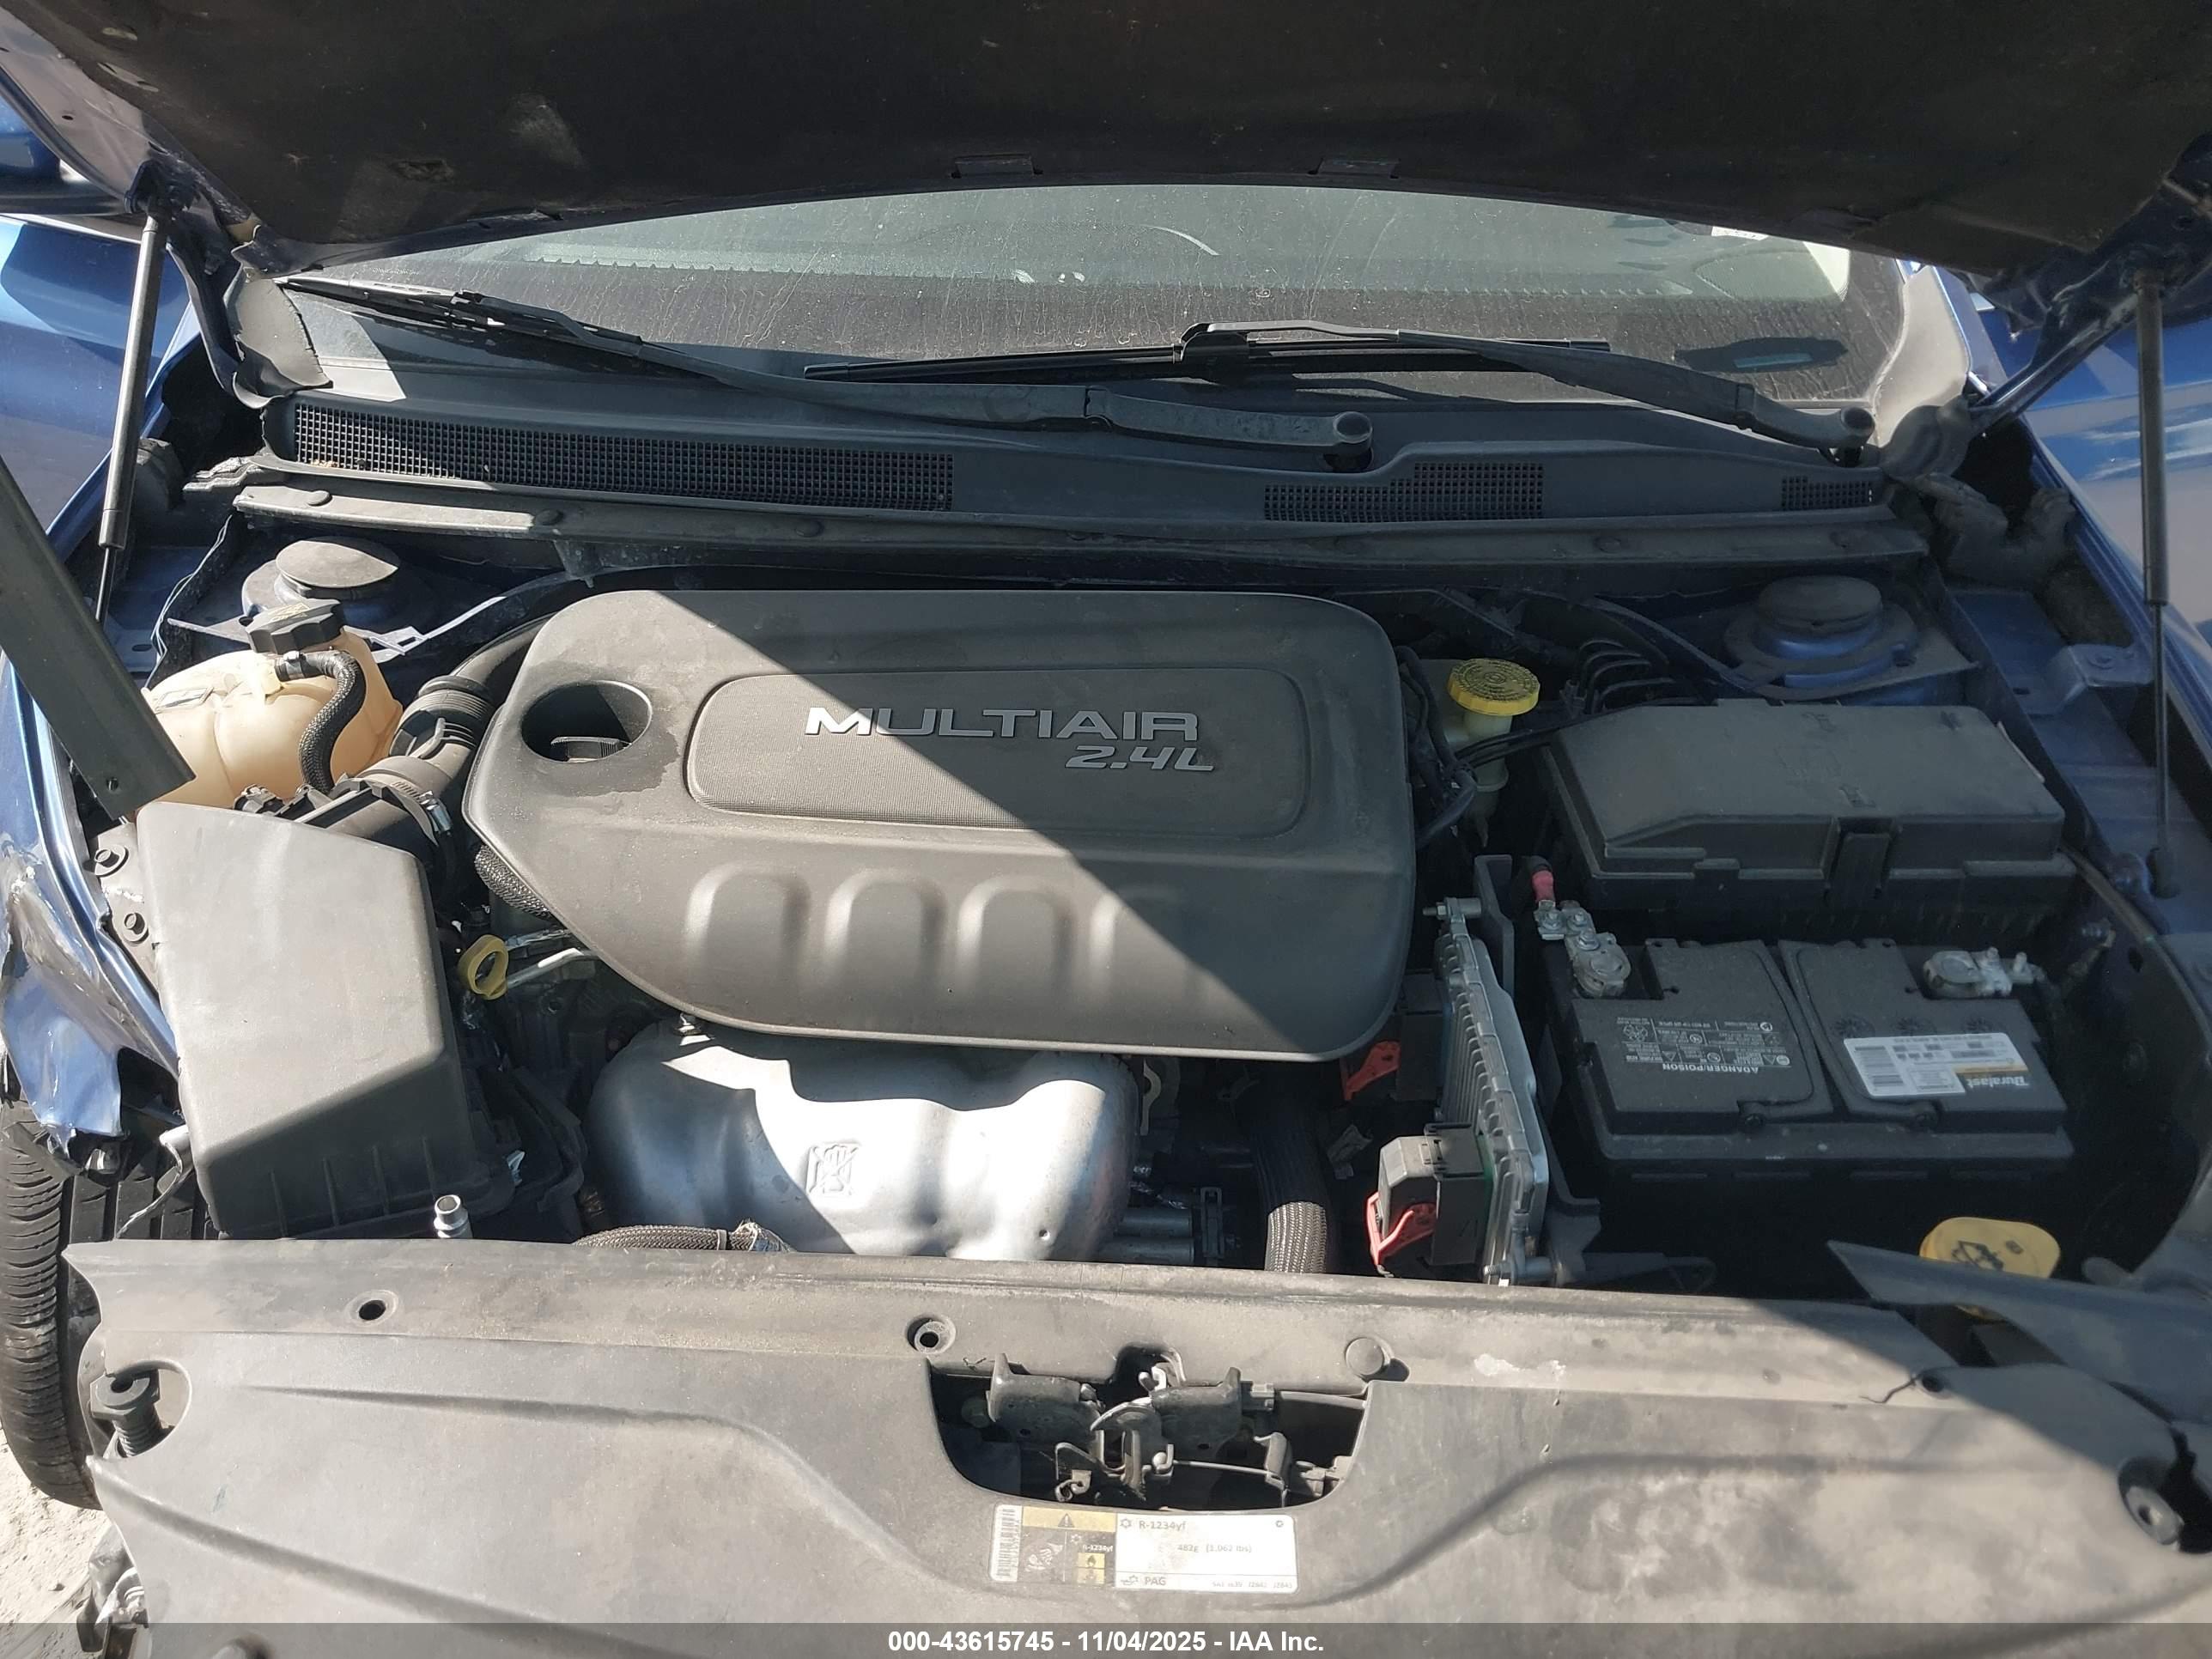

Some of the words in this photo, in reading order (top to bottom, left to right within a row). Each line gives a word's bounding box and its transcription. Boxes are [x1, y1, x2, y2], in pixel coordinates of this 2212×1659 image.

[805, 707, 1199, 741] MULTIAIR
[1065, 744, 1215, 772] 2.4L
[1965, 1076, 2030, 1089] Duralast
[1139, 1520, 1187, 1532] R-1234yf
[1144, 1577, 1167, 1586] PAG
